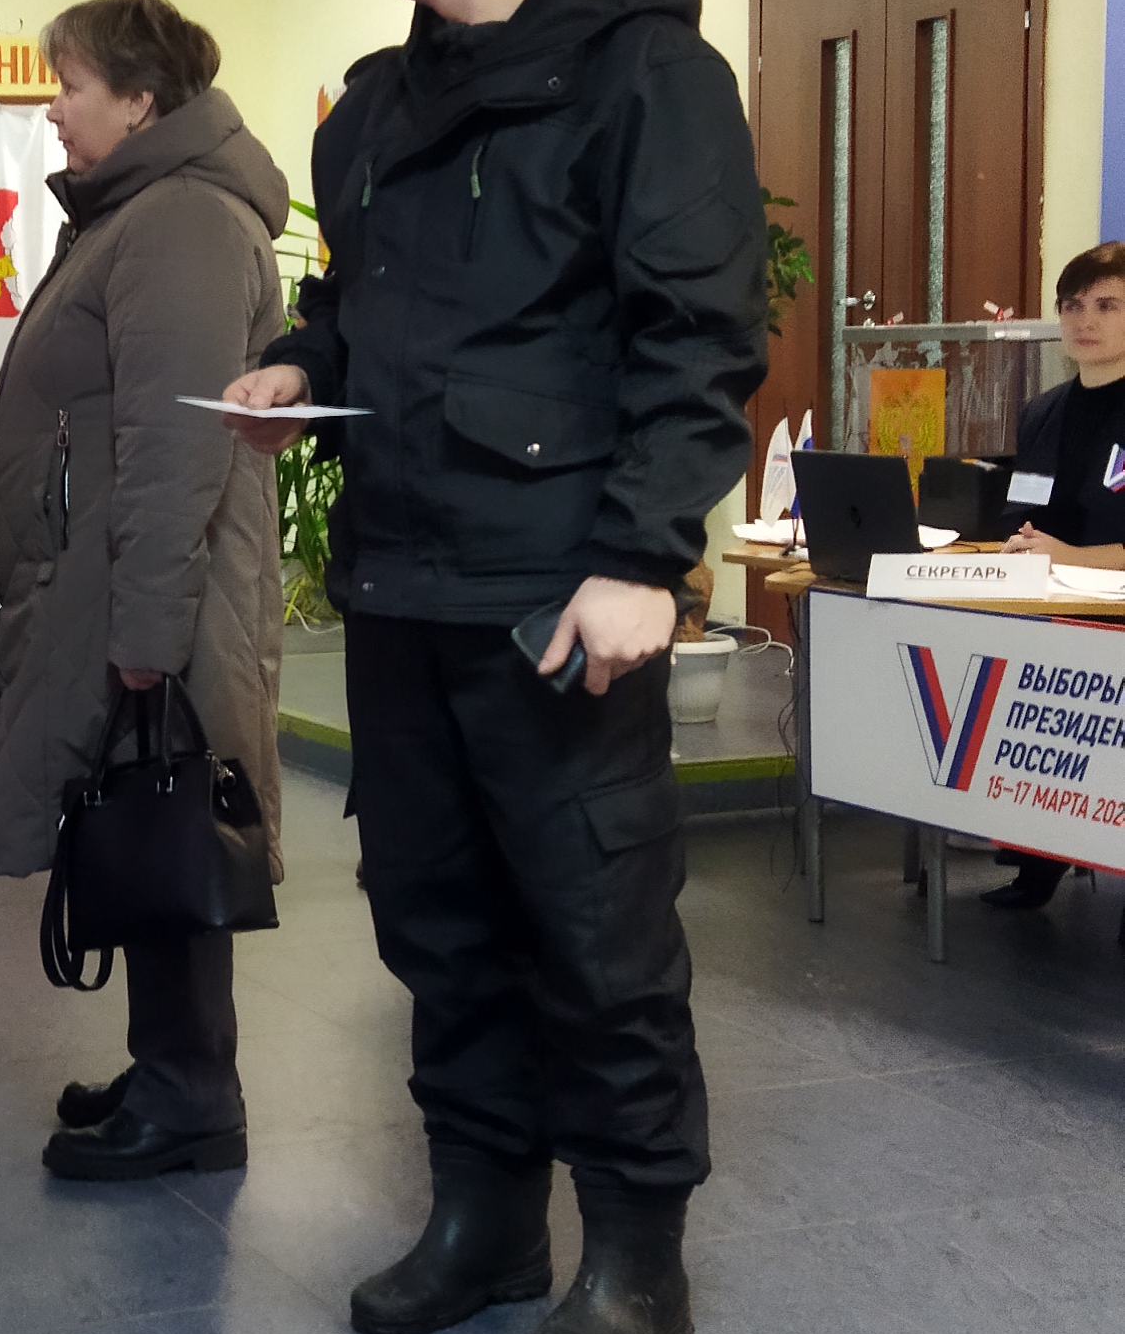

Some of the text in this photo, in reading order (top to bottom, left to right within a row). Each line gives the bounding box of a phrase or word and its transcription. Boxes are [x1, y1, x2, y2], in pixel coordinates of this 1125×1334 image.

[906, 565, 1007, 580] СЕКРЕТАРЬ
[1018, 662, 1125, 706] ВЫБОРЫ
[994, 738, 1090, 783] РОССИИ
[1031, 784, 1090, 819] МАРТА
